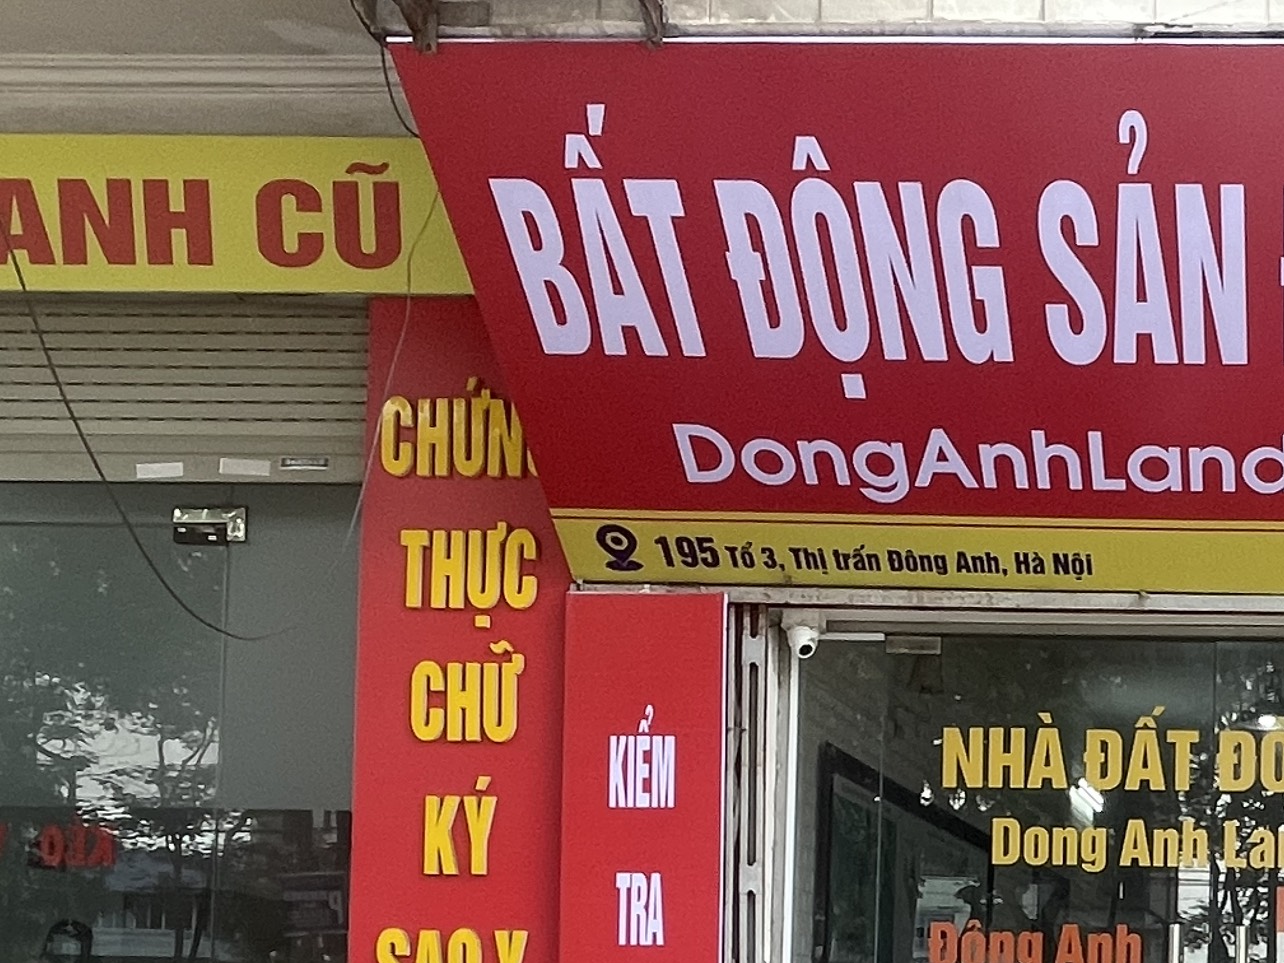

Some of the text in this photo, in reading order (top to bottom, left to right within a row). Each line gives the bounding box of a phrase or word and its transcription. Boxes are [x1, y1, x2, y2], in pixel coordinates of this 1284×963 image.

[0, 161, 402, 269] ANH CŨ
[488, 103, 706, 356] BẤT
[713, 136, 1014, 399] ĐỘNG
[1037, 109, 1248, 366] SẢN
[380, 376, 539, 477] CHỨN
[400, 521, 538, 629] THỰC
[654, 536, 721, 568] 195
[762, 547, 786, 571] 3,
[789, 546, 829, 575] Thị
[832, 544, 882, 572] trấn
[887, 549, 949, 575] Đông
[956, 551, 1008, 577] Anh,
[1014, 551, 1046, 575] Hà
[1053, 552, 1093, 580] Nội
[410, 639, 525, 743] CHỮ
[609, 704, 676, 809] KIỂM
[941, 712, 1068, 789] NHÀ
[1083, 706, 1199, 792] ĐẤT
[422, 775, 498, 875] KÝ
[991, 817, 1107, 872] Dong
[1120, 818, 1209, 868] Anh
[615, 872, 664, 946] TRA
